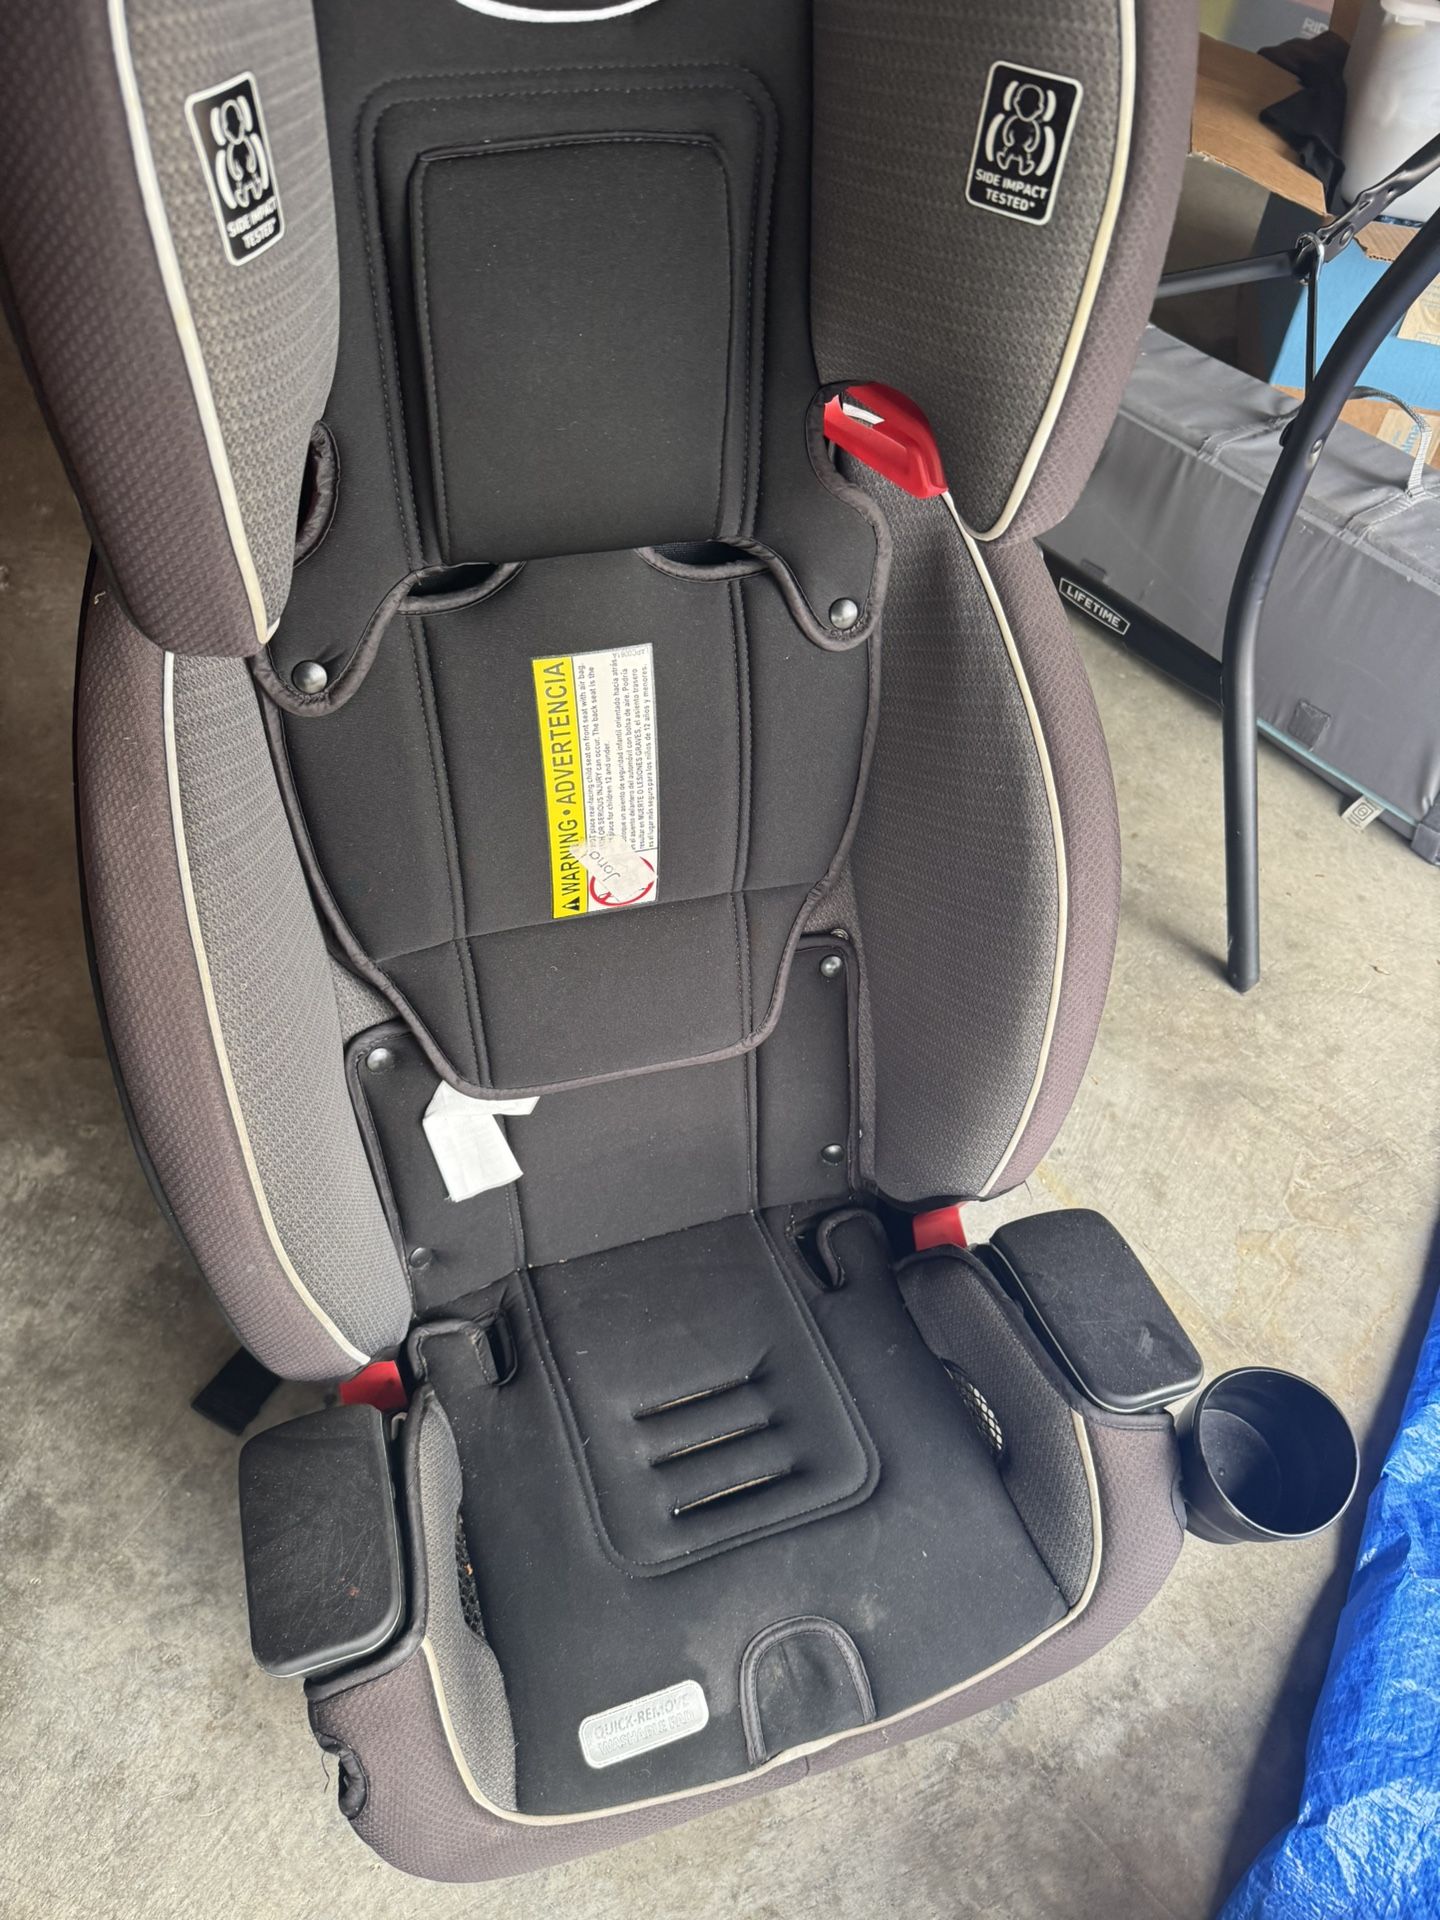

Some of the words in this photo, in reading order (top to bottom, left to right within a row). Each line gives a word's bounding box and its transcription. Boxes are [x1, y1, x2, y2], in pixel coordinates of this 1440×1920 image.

[975, 168, 1000, 187] SIDE
[1001, 177, 1049, 200] IMPACT
[226, 212, 252, 238] SIDE
[248, 195, 278, 226] IMPACT
[1066, 585, 1121, 628] LIFETIME
[612, 677, 620, 696] hacia
[620, 668, 629, 692] Podría
[591, 705, 599, 722] back
[613, 697, 622, 728] orientado
[623, 708, 631, 717] de
[633, 694, 641, 719] asiento
[543, 661, 577, 805] ADVERTENCIA
[582, 725, 590, 741] front
[624, 718, 632, 736] bolsa
[643, 723, 650, 731] 12
[644, 732, 651, 741] de
[585, 742, 591, 750] on
[615, 729, 623, 750] infantil
[644, 742, 652, 760] niños
[604, 763, 612, 776] and
[617, 751, 625, 782] seguridad
[635, 757, 643, 789] LESIONES
[595, 772, 603, 796] INJURY
[586, 784, 595, 817] rear-facing
[605, 785, 613, 810] children
[627, 790, 635, 817] delantero
[636, 795, 645, 820] MUERTE
[647, 787, 655, 807] seguro
[597, 796, 605, 825] SERIOUS
[588, 819, 596, 834] place
[557, 819, 581, 896] WARNING
